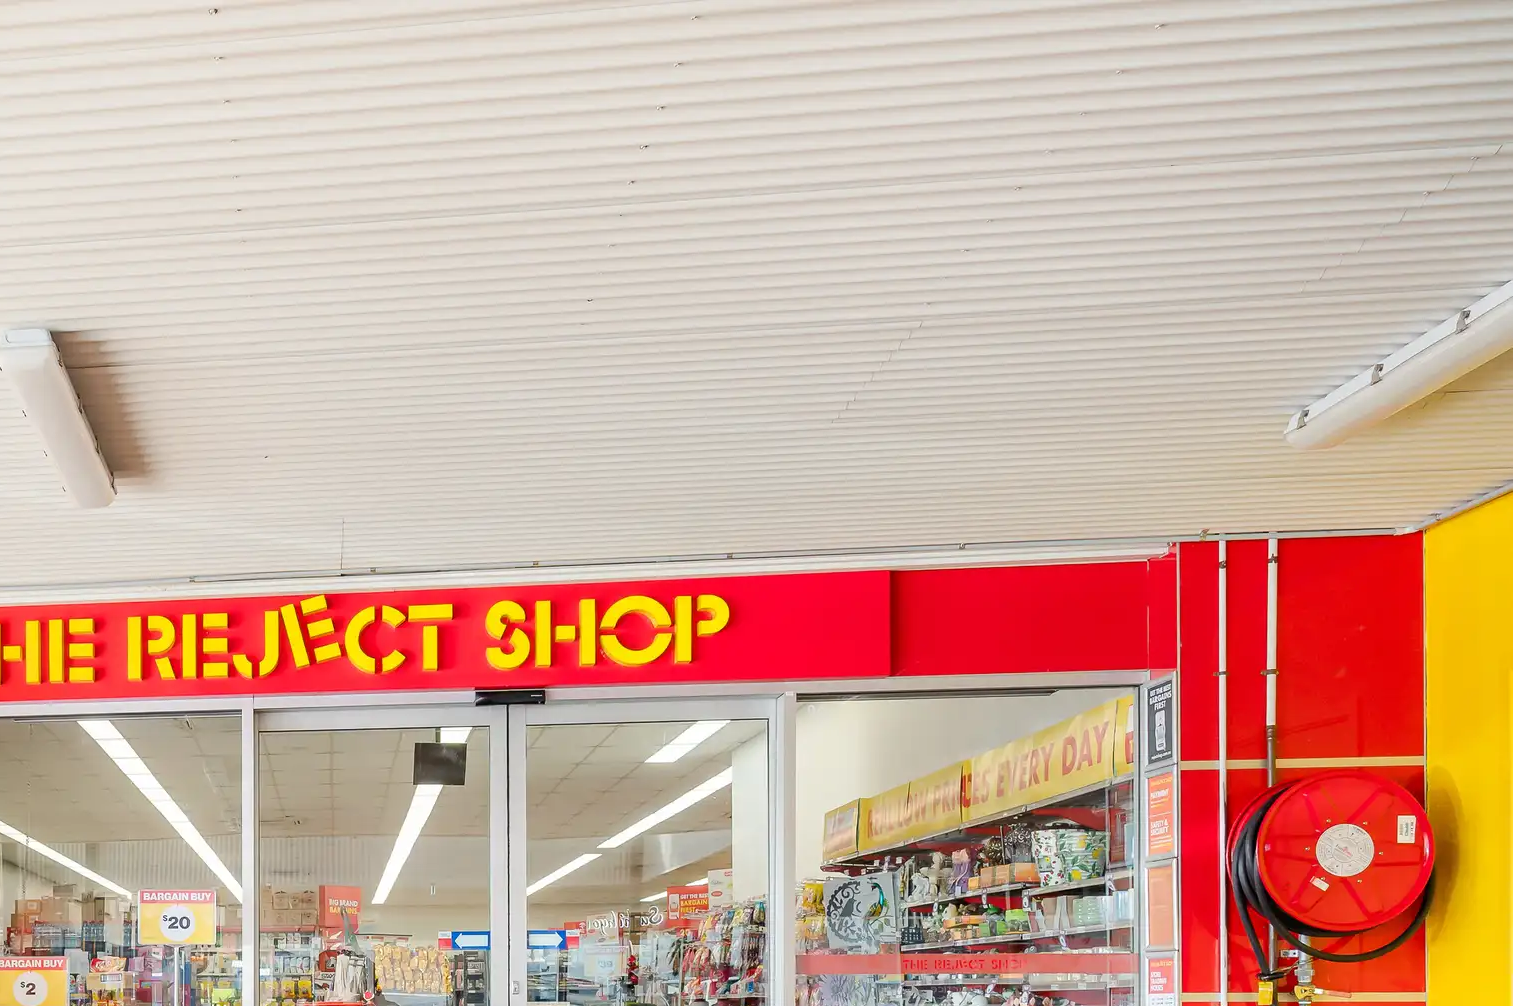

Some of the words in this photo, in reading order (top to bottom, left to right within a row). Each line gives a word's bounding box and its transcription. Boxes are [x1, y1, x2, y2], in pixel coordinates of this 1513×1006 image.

[127, 594, 454, 682] REJECT
[485, 594, 731, 670] SHOP
[1154, 700, 1167, 711] FIRST
[996, 742, 1055, 798] EVERY
[1061, 720, 1110, 776] DAY
[143, 892, 189, 901] BARGAIN
[190, 892, 212, 901] BUY
[162, 914, 191, 930] $20
[42, 959, 64, 968] BUY
[903, 959, 928, 970] THE
[20, 981, 36, 996] $2
